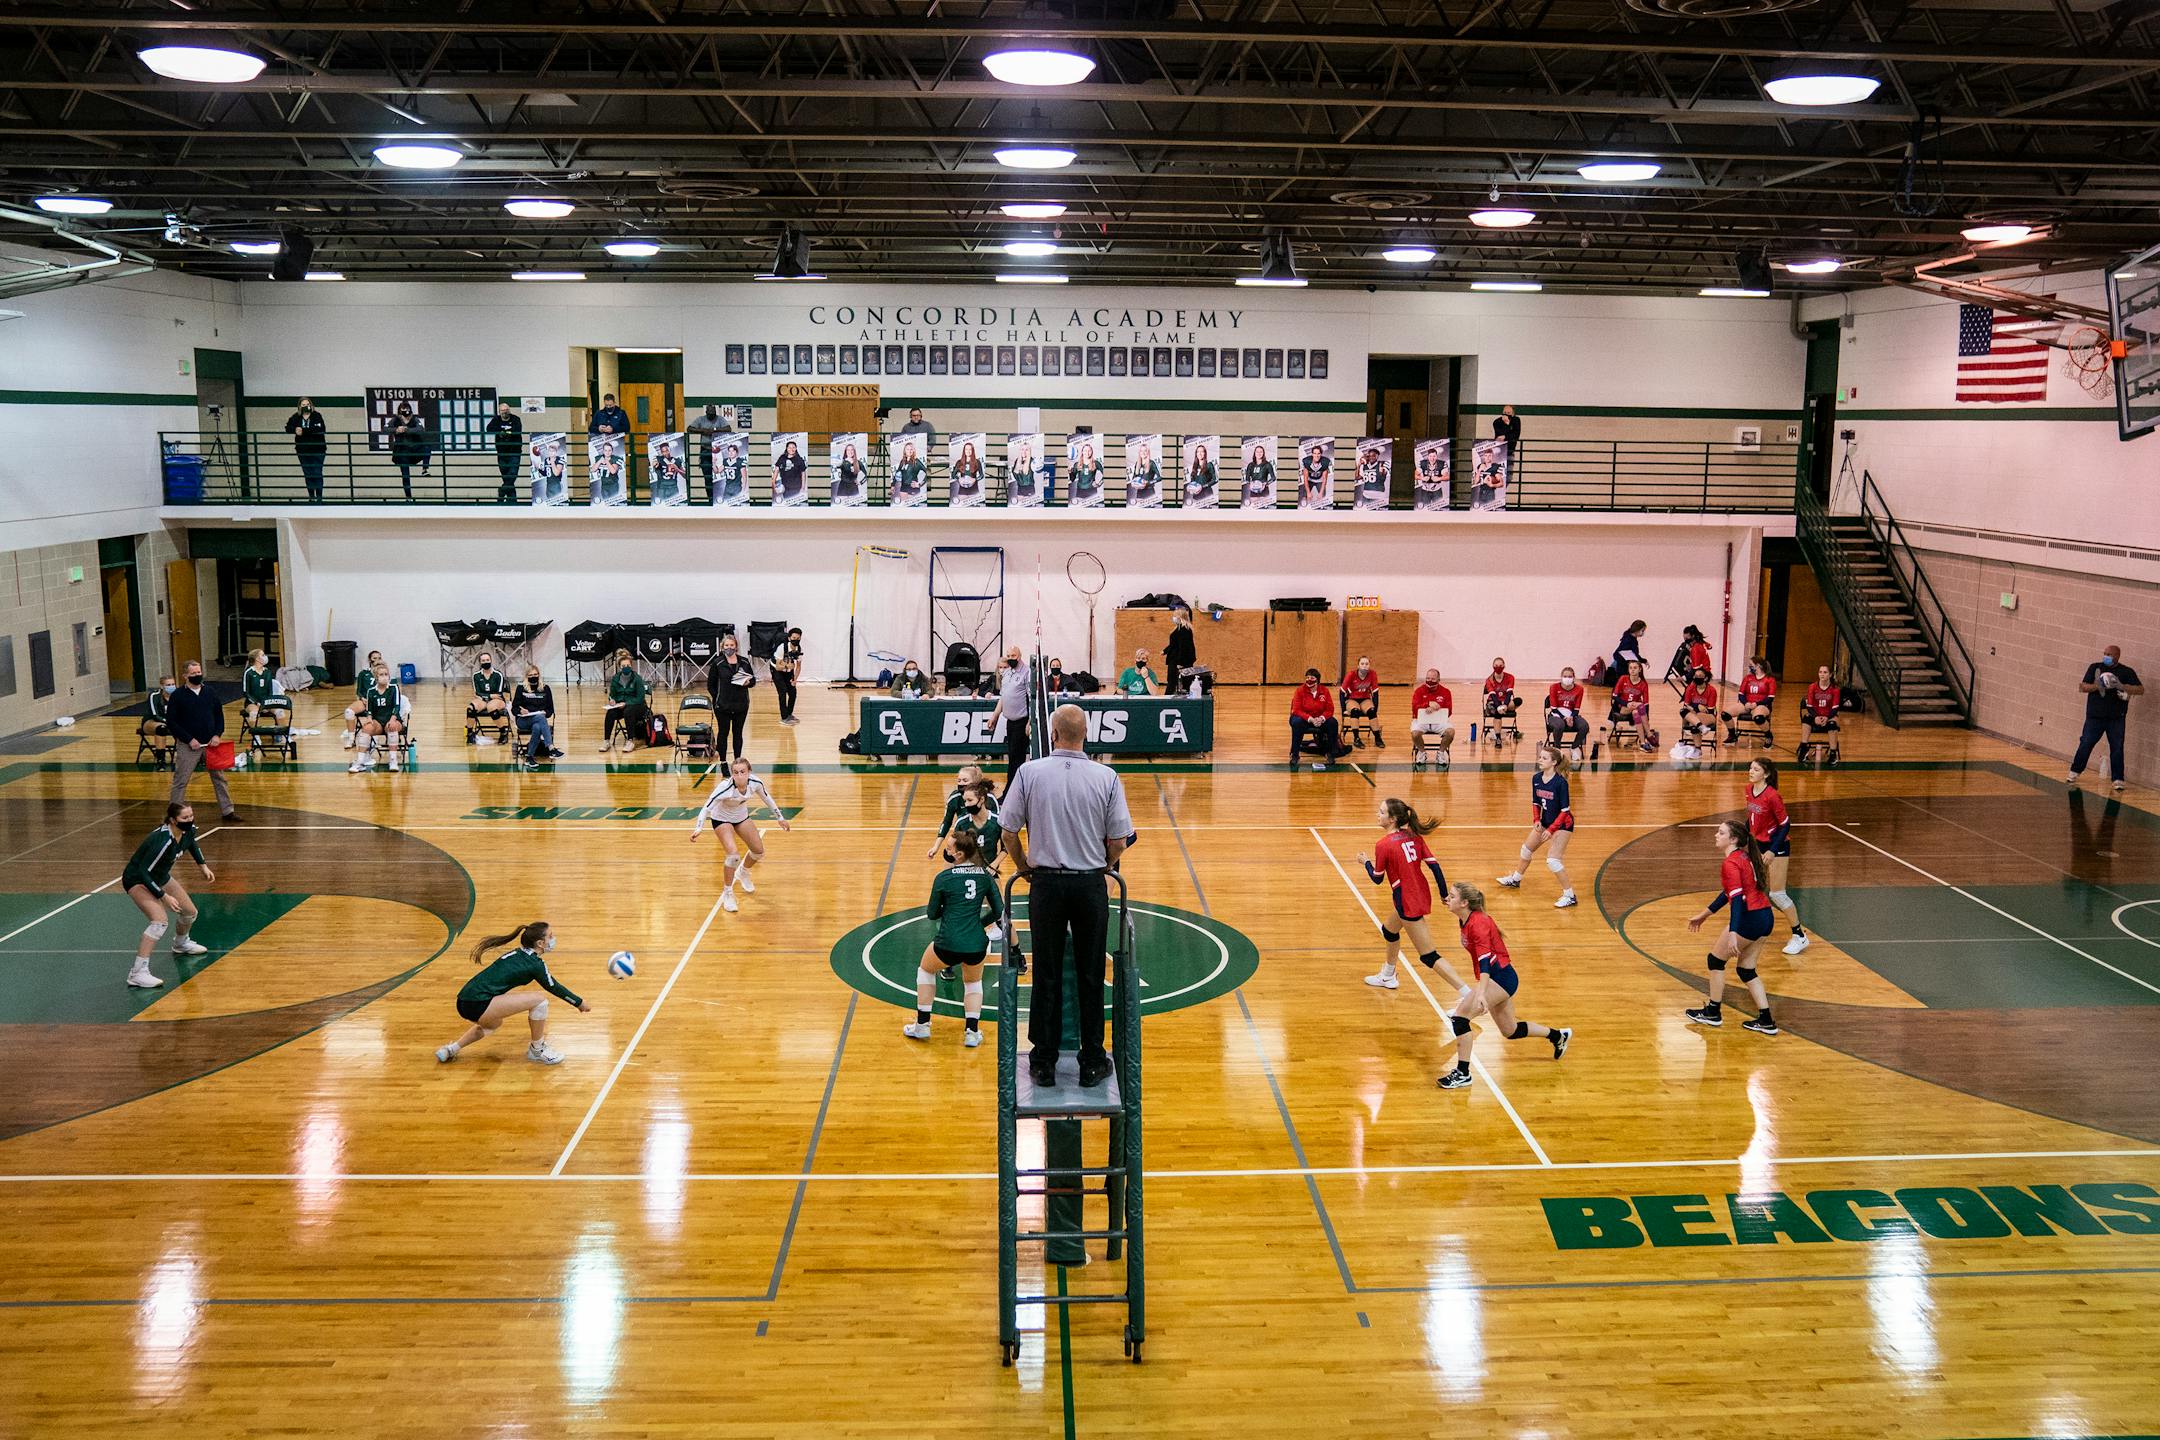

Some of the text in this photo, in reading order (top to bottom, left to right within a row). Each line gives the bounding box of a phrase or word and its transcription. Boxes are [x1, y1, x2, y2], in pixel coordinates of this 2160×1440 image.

[809, 306, 1245, 329] CONCORDIA ACADEMY
[859, 329, 1197, 344] ATHLETIC HALL OF FAME
[374, 389, 481, 399] VISION FOR LIFE
[777, 384, 879, 396] CONCESSIONS
[376, 697, 386, 707] 12
[878, 710, 909, 746] CA
[1159, 708, 1189, 744] CA
[976, 834, 985, 847] 4
[1401, 841, 1418, 864] 15
[964, 879, 977, 900] 3
[1540, 1183, 2160, 1250] BEACONS
